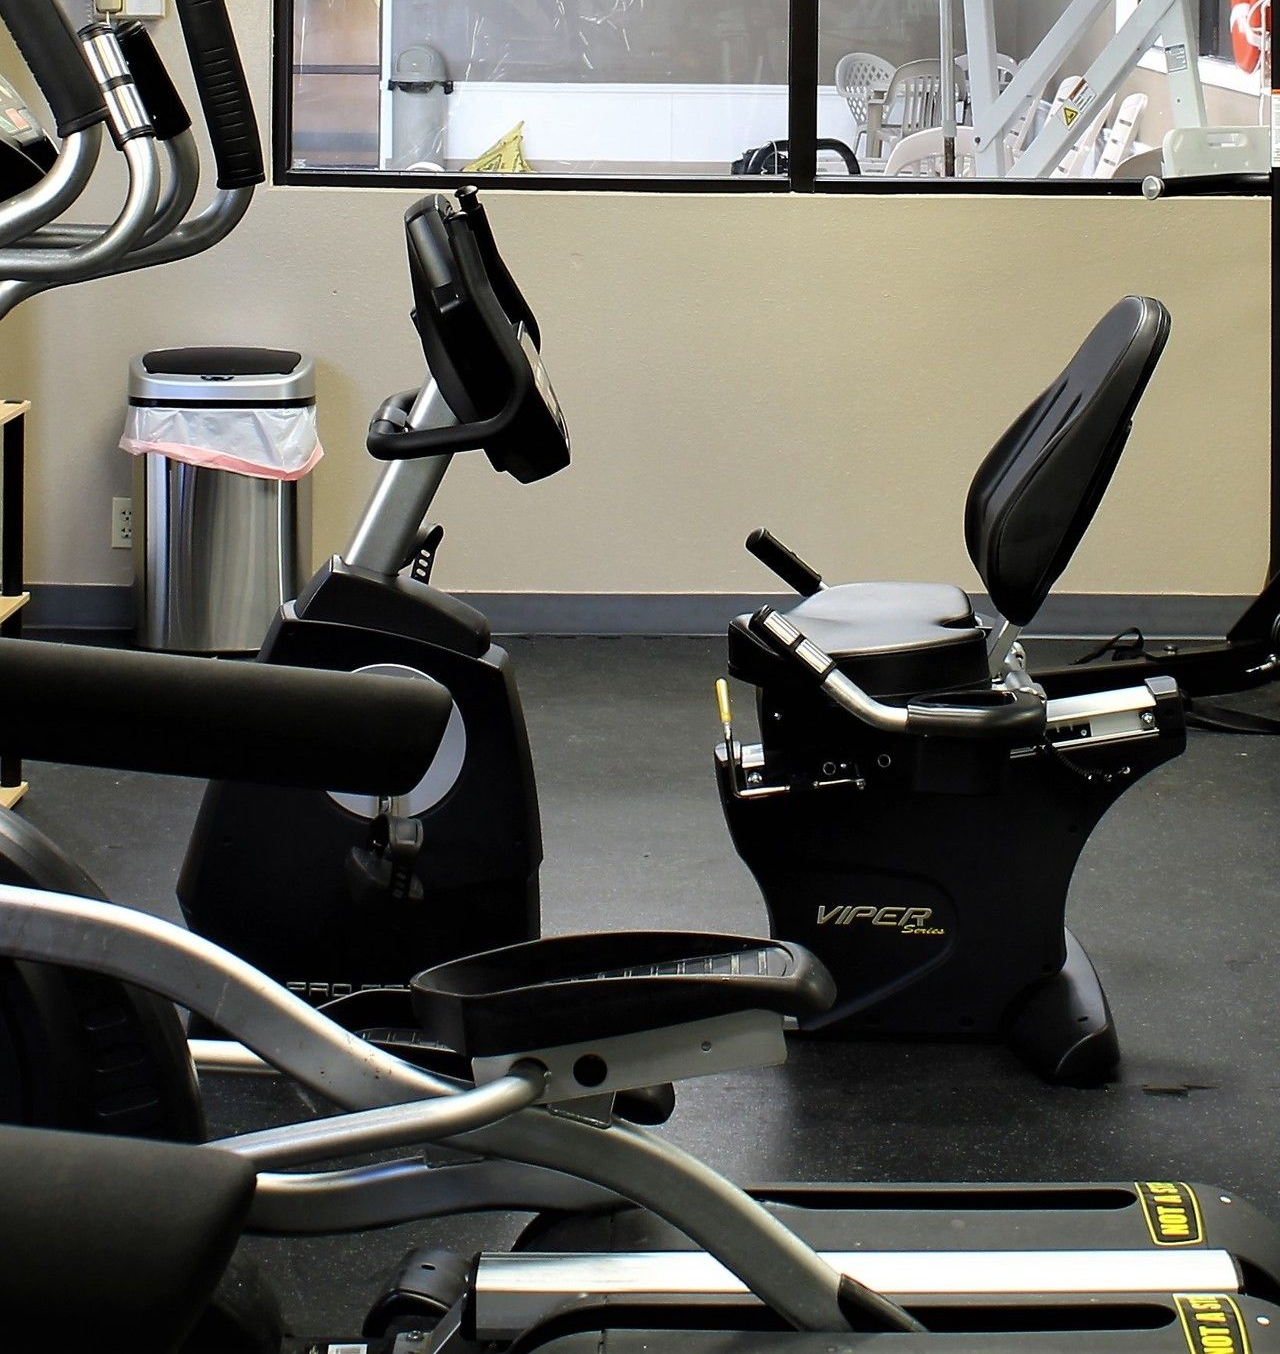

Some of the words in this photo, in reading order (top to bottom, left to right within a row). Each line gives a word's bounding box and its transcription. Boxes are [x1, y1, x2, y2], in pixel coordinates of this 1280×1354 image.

[816, 905, 932, 926] VIPER
[901, 924, 945, 935] Series
[1153, 1195, 1182, 1203] A
[1156, 1206, 1190, 1235] NOT
[1195, 1311, 1227, 1322] A
[1198, 1325, 1234, 1354] NOT
